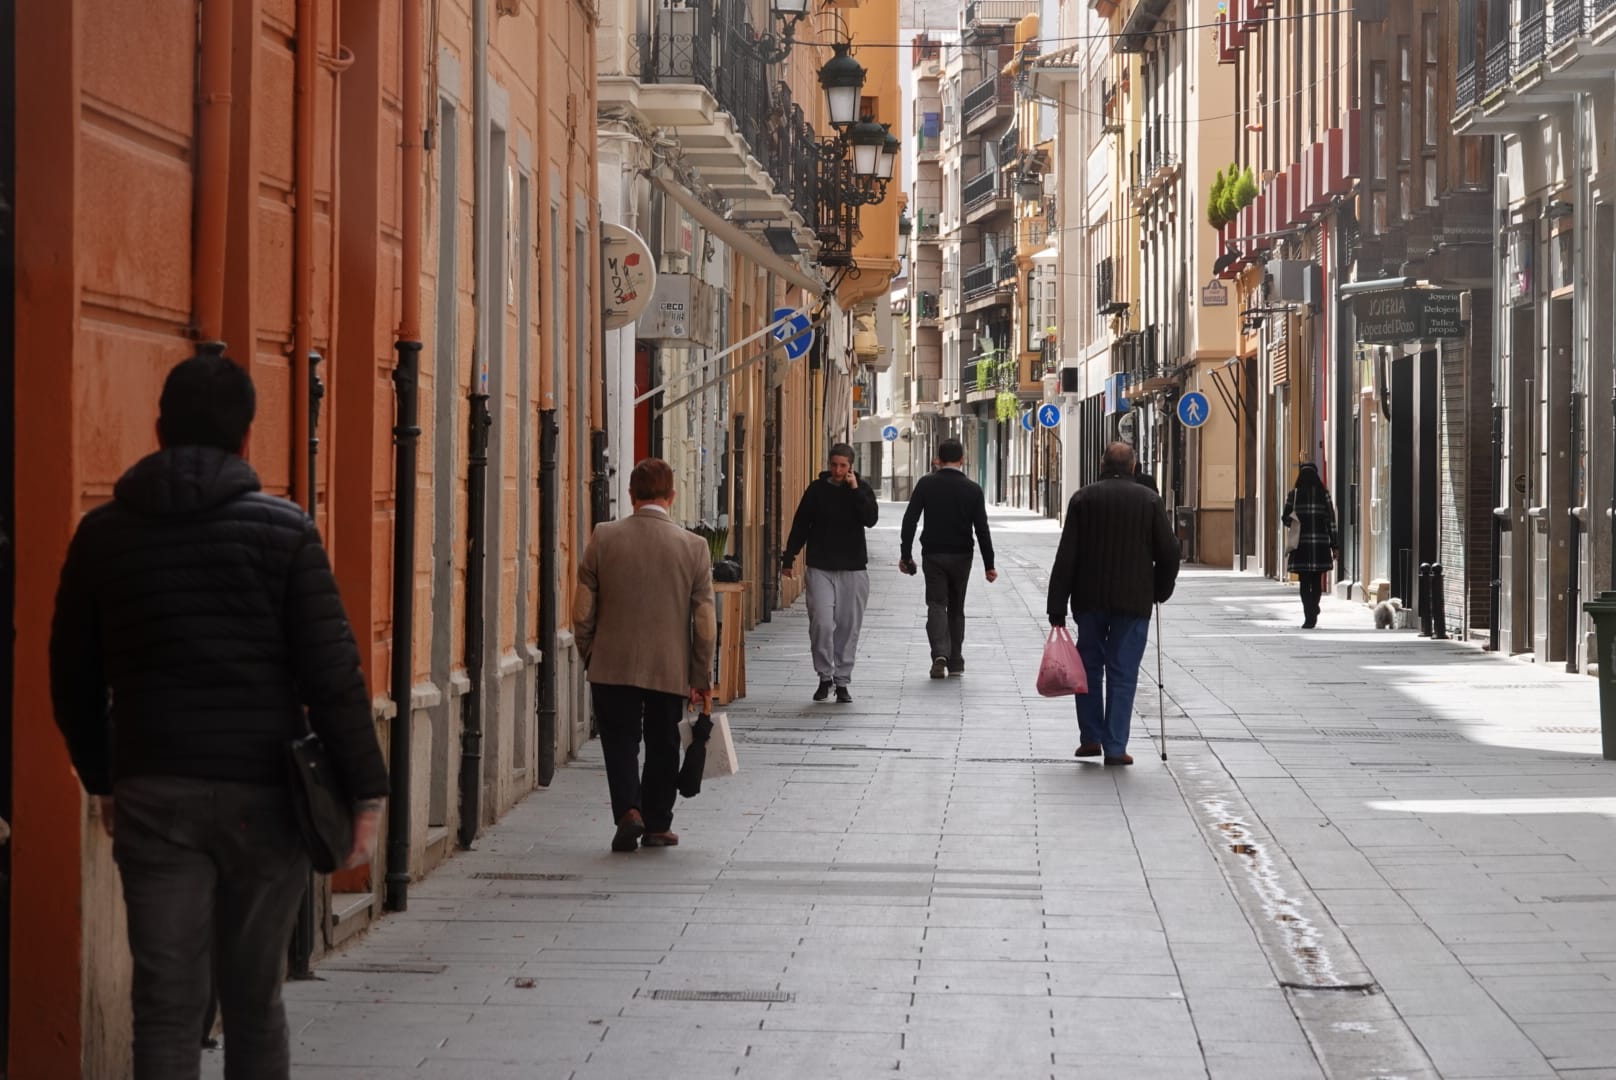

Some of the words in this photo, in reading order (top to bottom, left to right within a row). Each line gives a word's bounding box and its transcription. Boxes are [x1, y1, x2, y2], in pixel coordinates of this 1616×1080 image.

[1383, 319, 1394, 334] del
[1395, 319, 1415, 333] Pozo
[1428, 327, 1458, 335] propio
